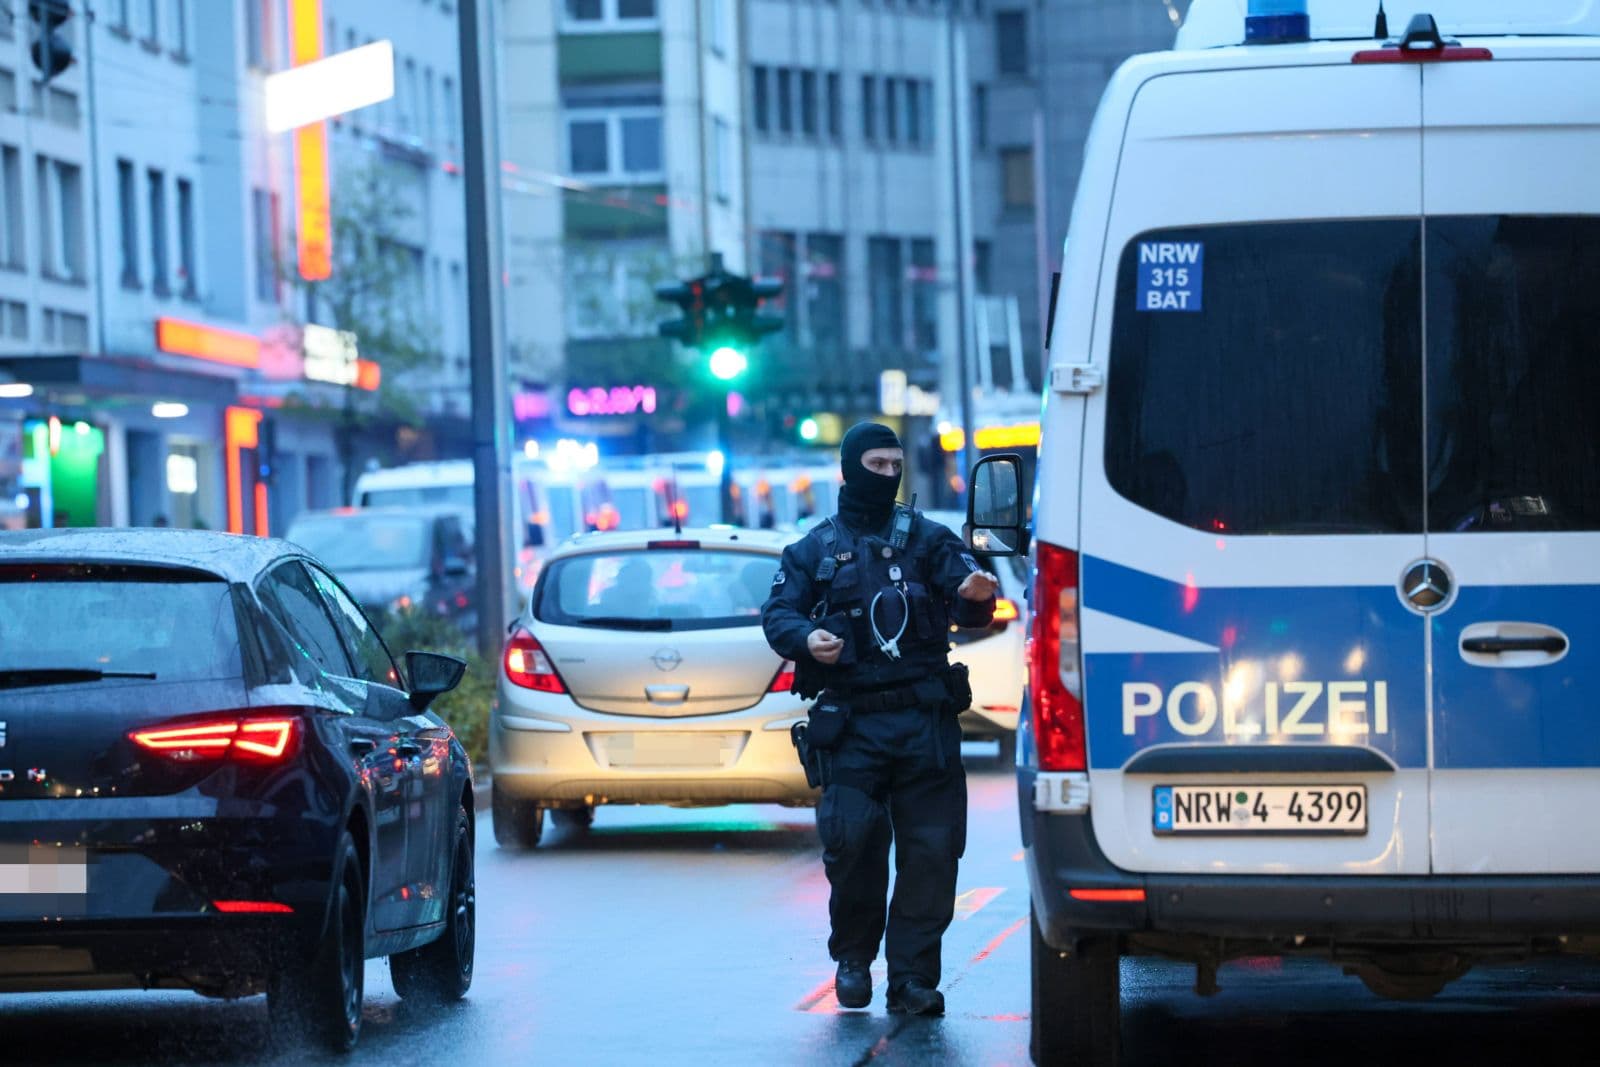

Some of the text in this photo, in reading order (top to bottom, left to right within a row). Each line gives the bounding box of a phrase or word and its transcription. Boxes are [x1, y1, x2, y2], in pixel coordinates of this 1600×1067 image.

[1140, 243, 1200, 264] NRW
[1151, 268, 1189, 287] 315
[1147, 290, 1191, 309] BAT
[1121, 680, 1389, 737] POLIZEI
[1174, 791, 1232, 824] NRW
